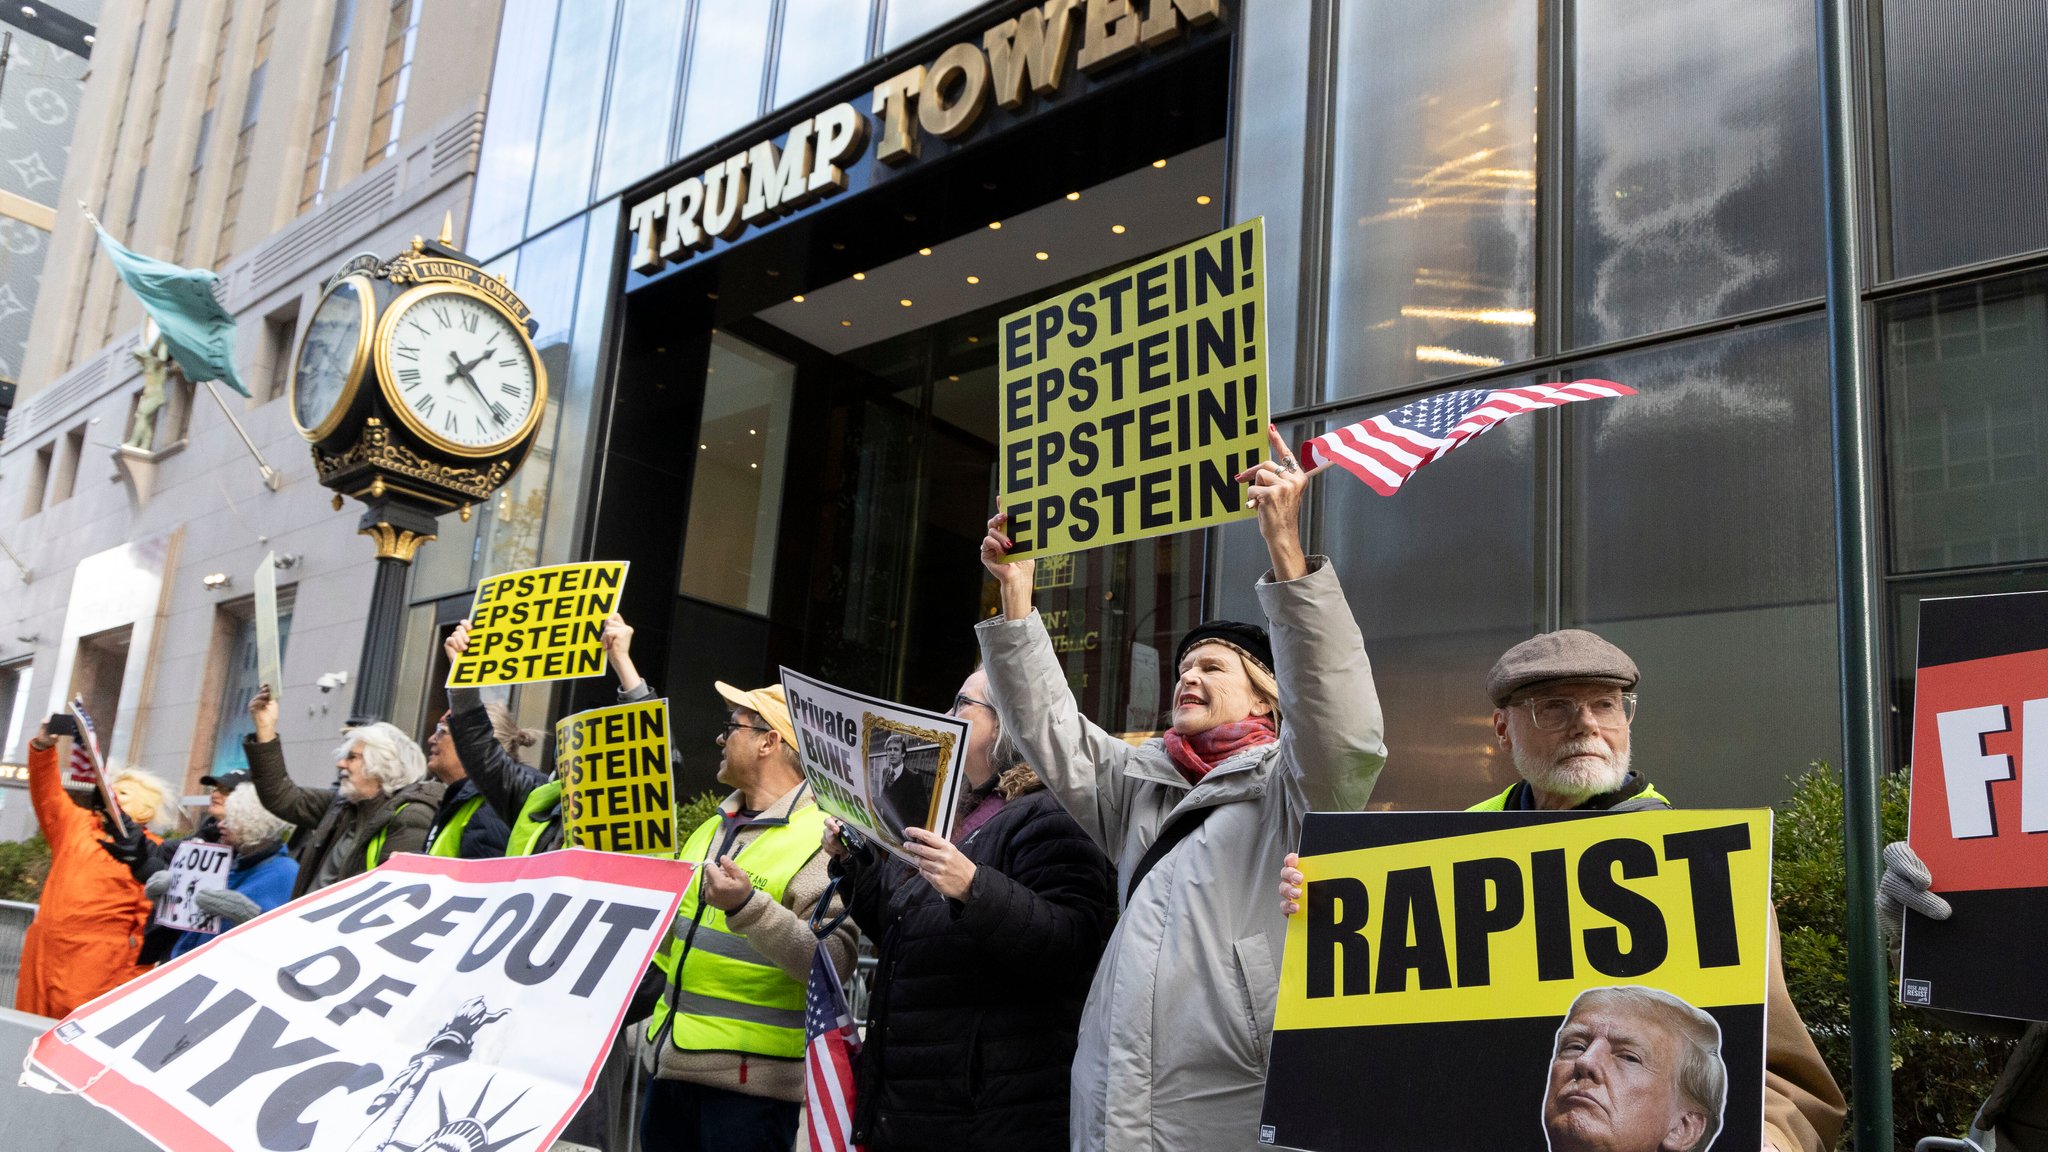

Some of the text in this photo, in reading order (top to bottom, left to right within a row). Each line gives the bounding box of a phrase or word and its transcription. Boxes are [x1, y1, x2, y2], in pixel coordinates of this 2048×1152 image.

[628, 102, 870, 277] TRUMP
[418, 263, 524, 315] TRUMP TOWER
[1005, 228, 1255, 372] EPSTEIN!
[1006, 300, 1256, 432] EPSTEIN!
[1006, 374, 1258, 494] EPSTEIN!
[472, 593, 615, 630] EPSTEIN
[478, 567, 621, 605] EPSTEIN
[453, 648, 603, 683] EPSTEIN
[462, 620, 606, 657] EPSTEIN
[557, 708, 664, 752] EPSTEIN
[789, 688, 857, 748] Private
[558, 744, 667, 787] EPSTEIN
[801, 726, 855, 787] BONE
[806, 764, 873, 829] SPURS
[187, 848, 228, 874] OUT
[299, 881, 662, 998] ICE OUT
[1306, 822, 1751, 999] RAPIST
[277, 945, 418, 1027] OF
[1906, 990, 1928, 998] RESIST
[94, 973, 384, 1152] NYC
